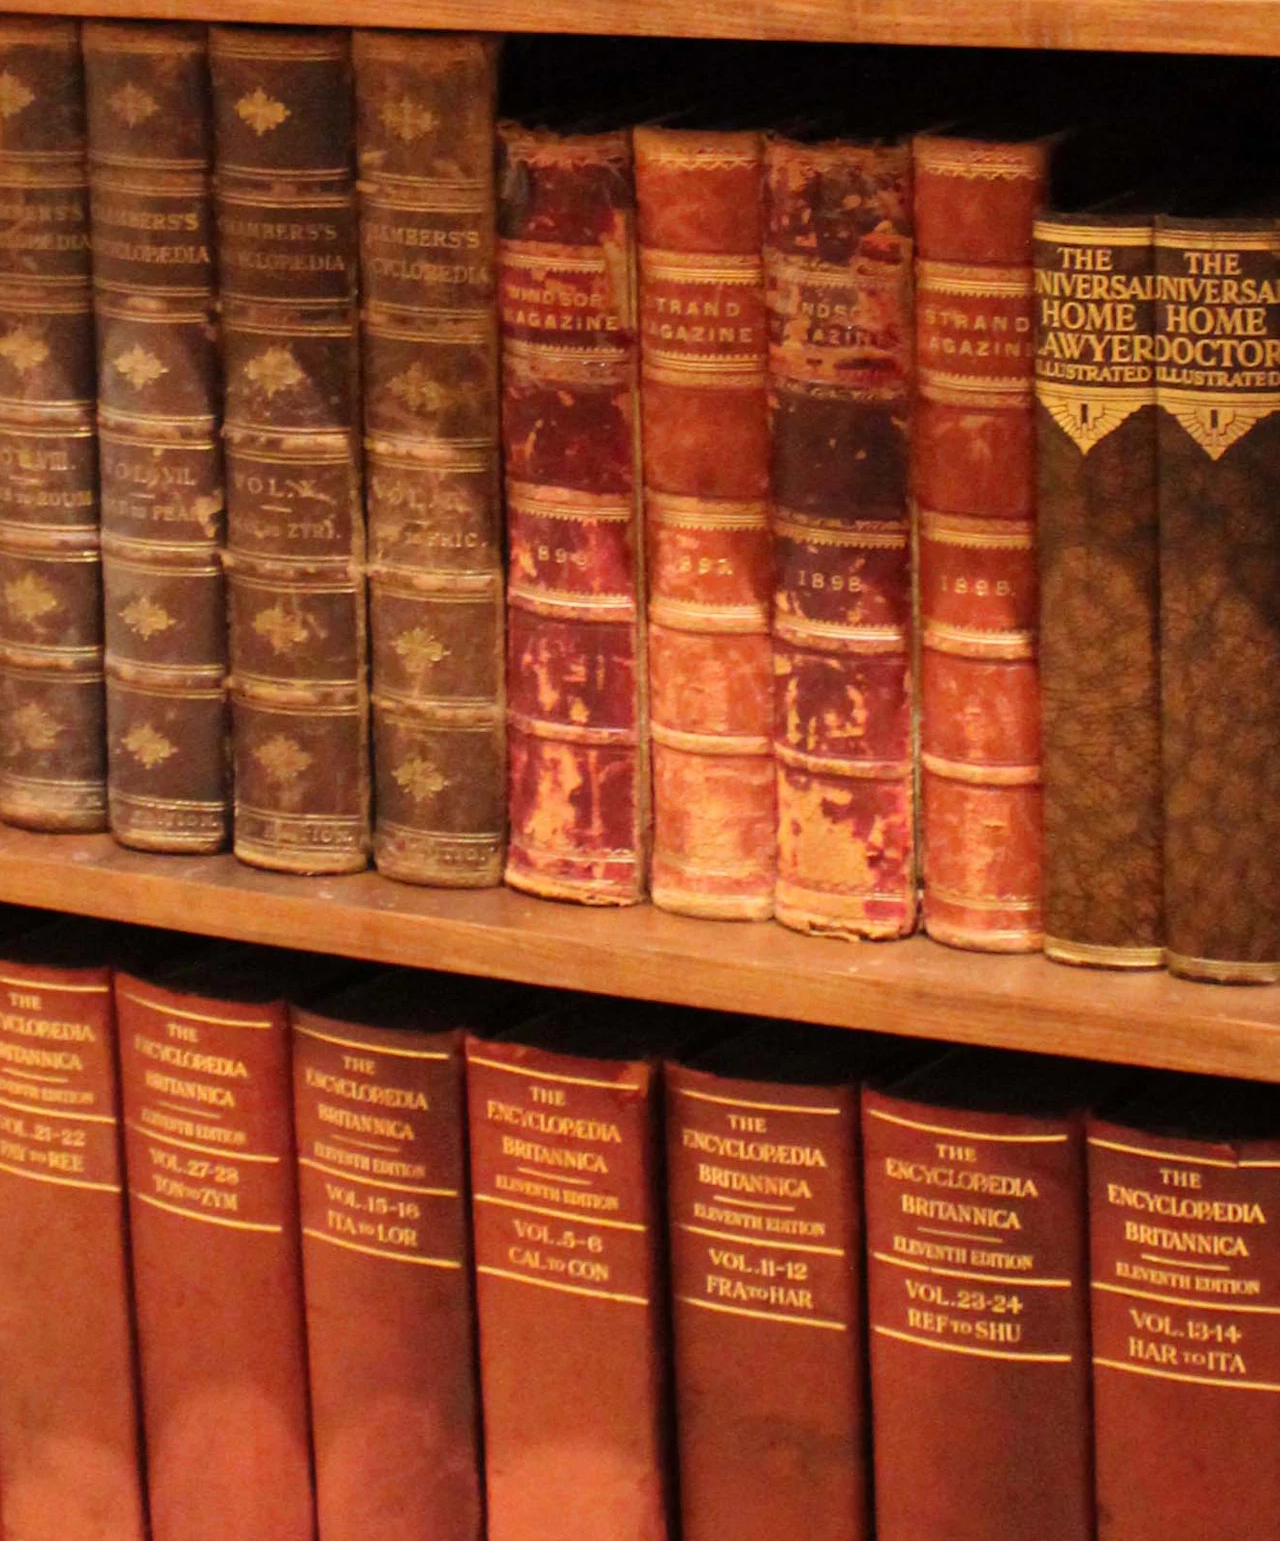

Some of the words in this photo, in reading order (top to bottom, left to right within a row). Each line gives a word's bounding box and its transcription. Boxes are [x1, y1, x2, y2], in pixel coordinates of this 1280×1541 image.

[1057, 247, 1113, 271] THE
[1183, 252, 1242, 275] THE
[925, 308, 1030, 334] STRAND
[1041, 300, 1137, 331] HOME
[1166, 307, 1268, 336] HOME
[1038, 332, 1154, 363] AWYER
[342, 1056, 375, 1076] THE
[530, 1087, 565, 1107] THE
[318, 1103, 415, 1141] BRITANNICA
[728, 1114, 768, 1134] THE
[373, 1157, 425, 1179] EDITION
[501, 1136, 609, 1174] BRITANNICA
[935, 1143, 977, 1163] THE
[698, 1163, 812, 1200] BRITANNICA
[886, 1157, 1039, 1199] ENCYCLOPÆDIA
[1159, 1168, 1203, 1190] THE
[562, 1191, 619, 1210] EDITION
[901, 1194, 1021, 1231] BRITANNICA
[1107, 1183, 1267, 1225] ENCYCLOPÆDIA
[327, 1209, 356, 1235] ITA
[377, 1224, 418, 1248] LOR
[693, 1202, 763, 1231] ELEVENTH
[765, 1216, 826, 1237] EDITION
[893, 1235, 967, 1266] ELEVENTH
[970, 1249, 1034, 1272] EDITION
[1125, 1221, 1250, 1258] BRITANNICA
[509, 1246, 546, 1271] CAL
[567, 1258, 610, 1282] CON
[762, 1259, 808, 1280] 11-12
[1116, 1261, 1191, 1290] ELEVENTH
[1195, 1274, 1261, 1296] EDITION
[707, 1274, 747, 1301] FRA
[769, 1285, 813, 1309] HAR
[905, 1279, 956, 1307] VOL.
[957, 1289, 1024, 1314] 23-24
[908, 1307, 948, 1334] REF
[975, 1321, 1021, 1342] SHU
[1129, 1307, 1184, 1338] VOL.
[1187, 1320, 1242, 1344] 13-14
[1129, 1336, 1179, 1366] HAR
[1207, 1350, 1247, 1374] ITA
